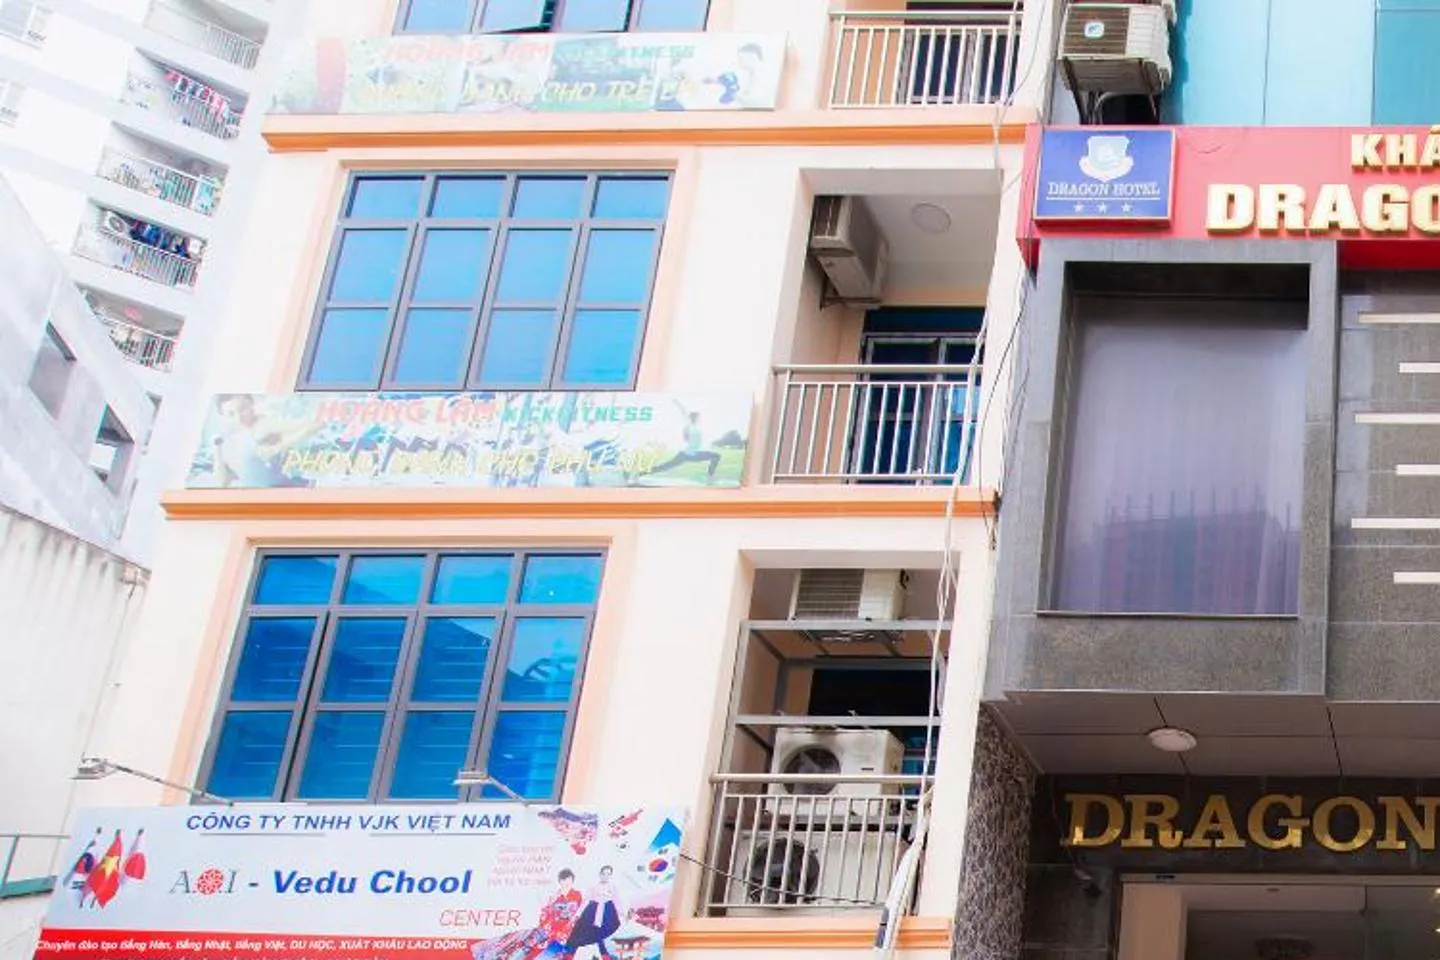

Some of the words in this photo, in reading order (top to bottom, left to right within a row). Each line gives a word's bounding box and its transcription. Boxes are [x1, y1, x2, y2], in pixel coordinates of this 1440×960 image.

[1048, 182, 1109, 196] DRAGON
[1113, 183, 1161, 197] HOTEL
[187, 812, 251, 830] CÔNG
[259, 815, 287, 830] TY
[293, 815, 351, 830] TNHH
[359, 815, 400, 830] VJK
[407, 814, 455, 832] VIỆT
[462, 814, 512, 829] NAM
[273, 869, 358, 895] Vedu
[370, 868, 474, 895] Chool
[440, 908, 522, 928] CENTER
